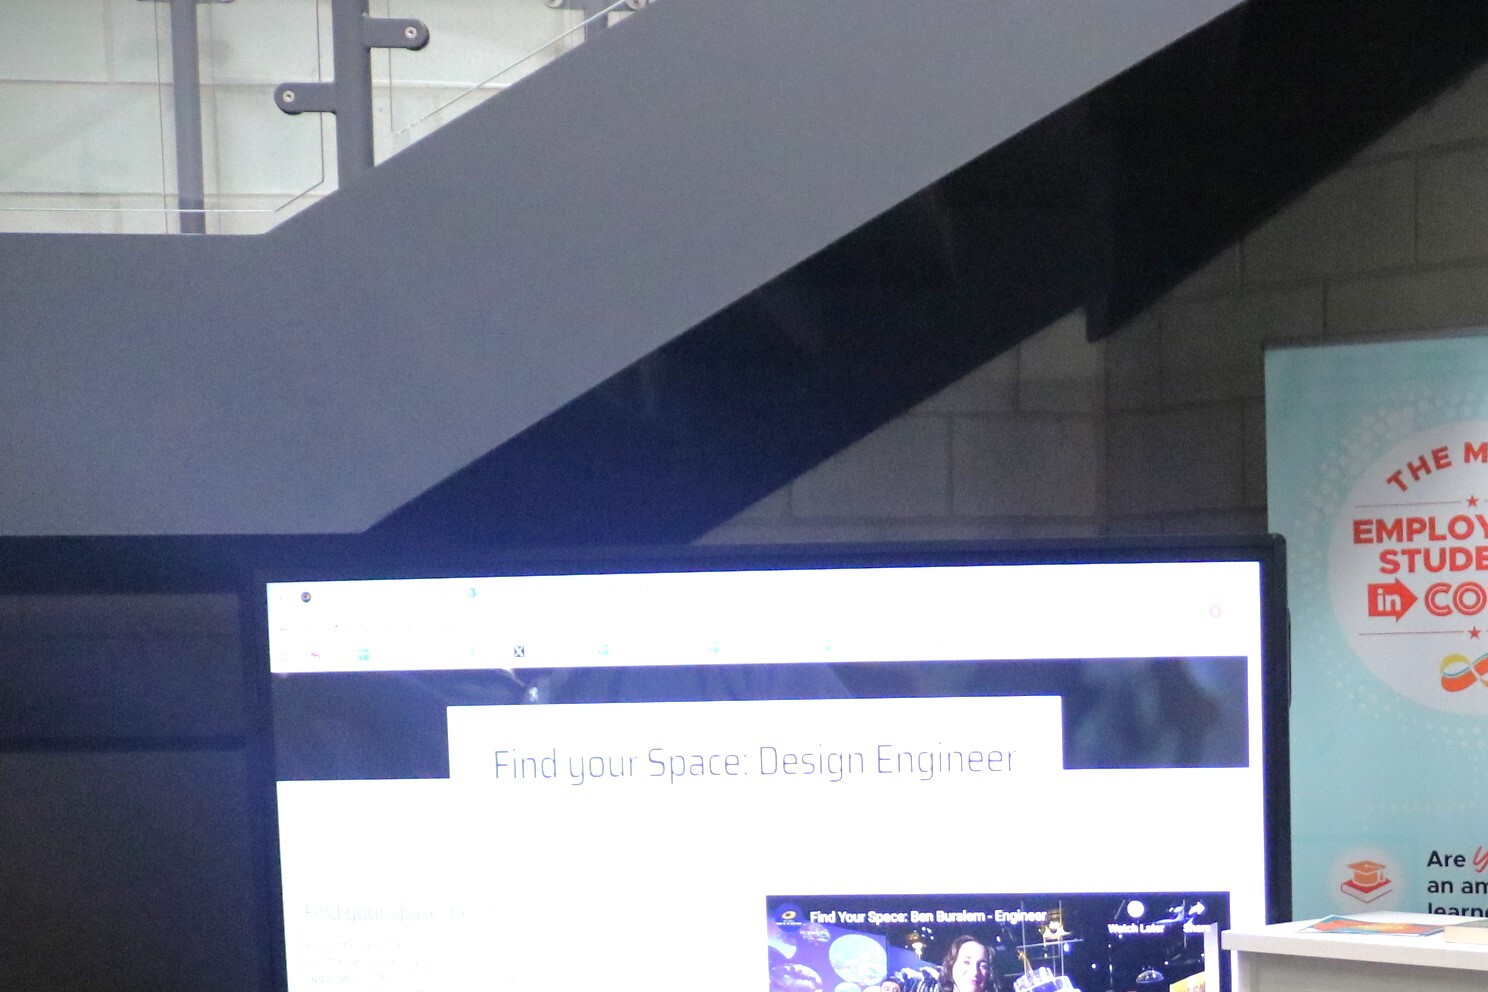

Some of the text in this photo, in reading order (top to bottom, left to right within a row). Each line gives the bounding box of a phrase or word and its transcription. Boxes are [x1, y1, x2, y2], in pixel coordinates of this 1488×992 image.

[1386, 446, 1452, 492] THE
[1376, 588, 1401, 611] in
[495, 742, 1016, 786] Find your Space: Design Engineer
[1427, 850, 1466, 867] Are
[1428, 880, 1453, 894] an
[810, 911, 835, 923] Find
[837, 911, 865, 923] Your
[868, 911, 908, 925] Space:
[911, 911, 933, 922] Ben
[995, 909, 1046, 924] Engineer
